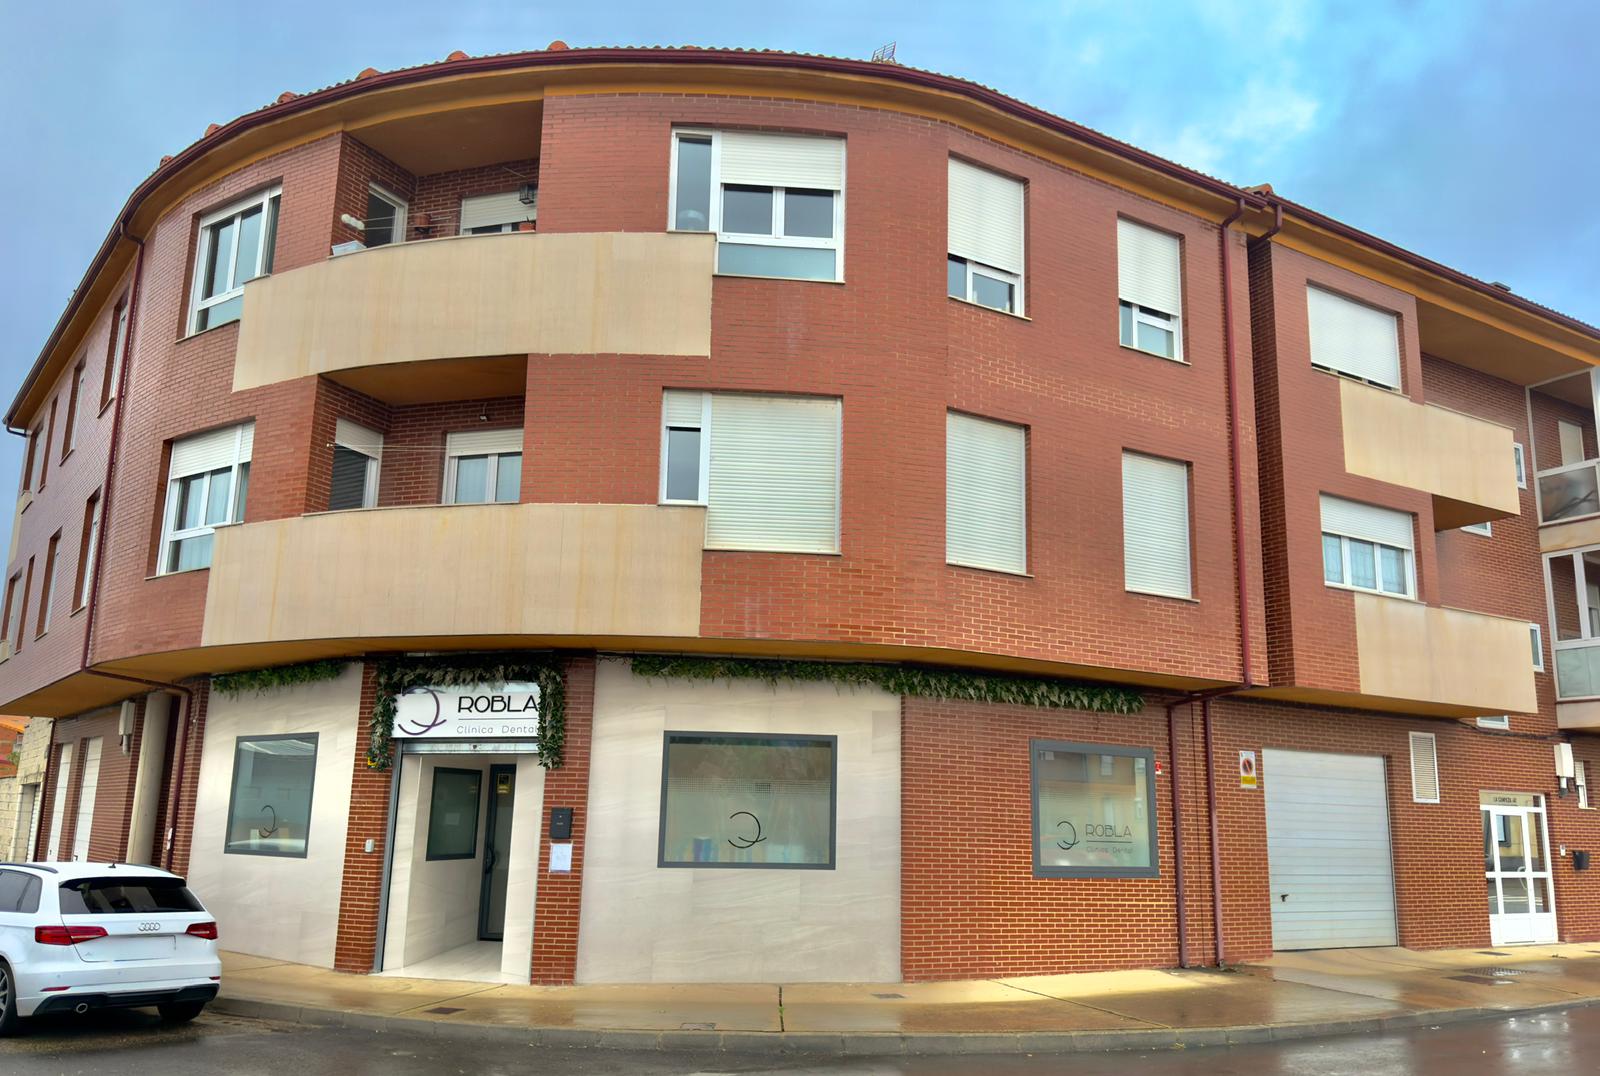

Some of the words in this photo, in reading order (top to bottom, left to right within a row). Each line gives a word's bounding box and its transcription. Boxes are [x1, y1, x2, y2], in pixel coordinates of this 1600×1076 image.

[457, 695, 539, 713] ROBLA
[501, 725, 538, 734] Dental
[1085, 823, 1132, 838] ROBLA
